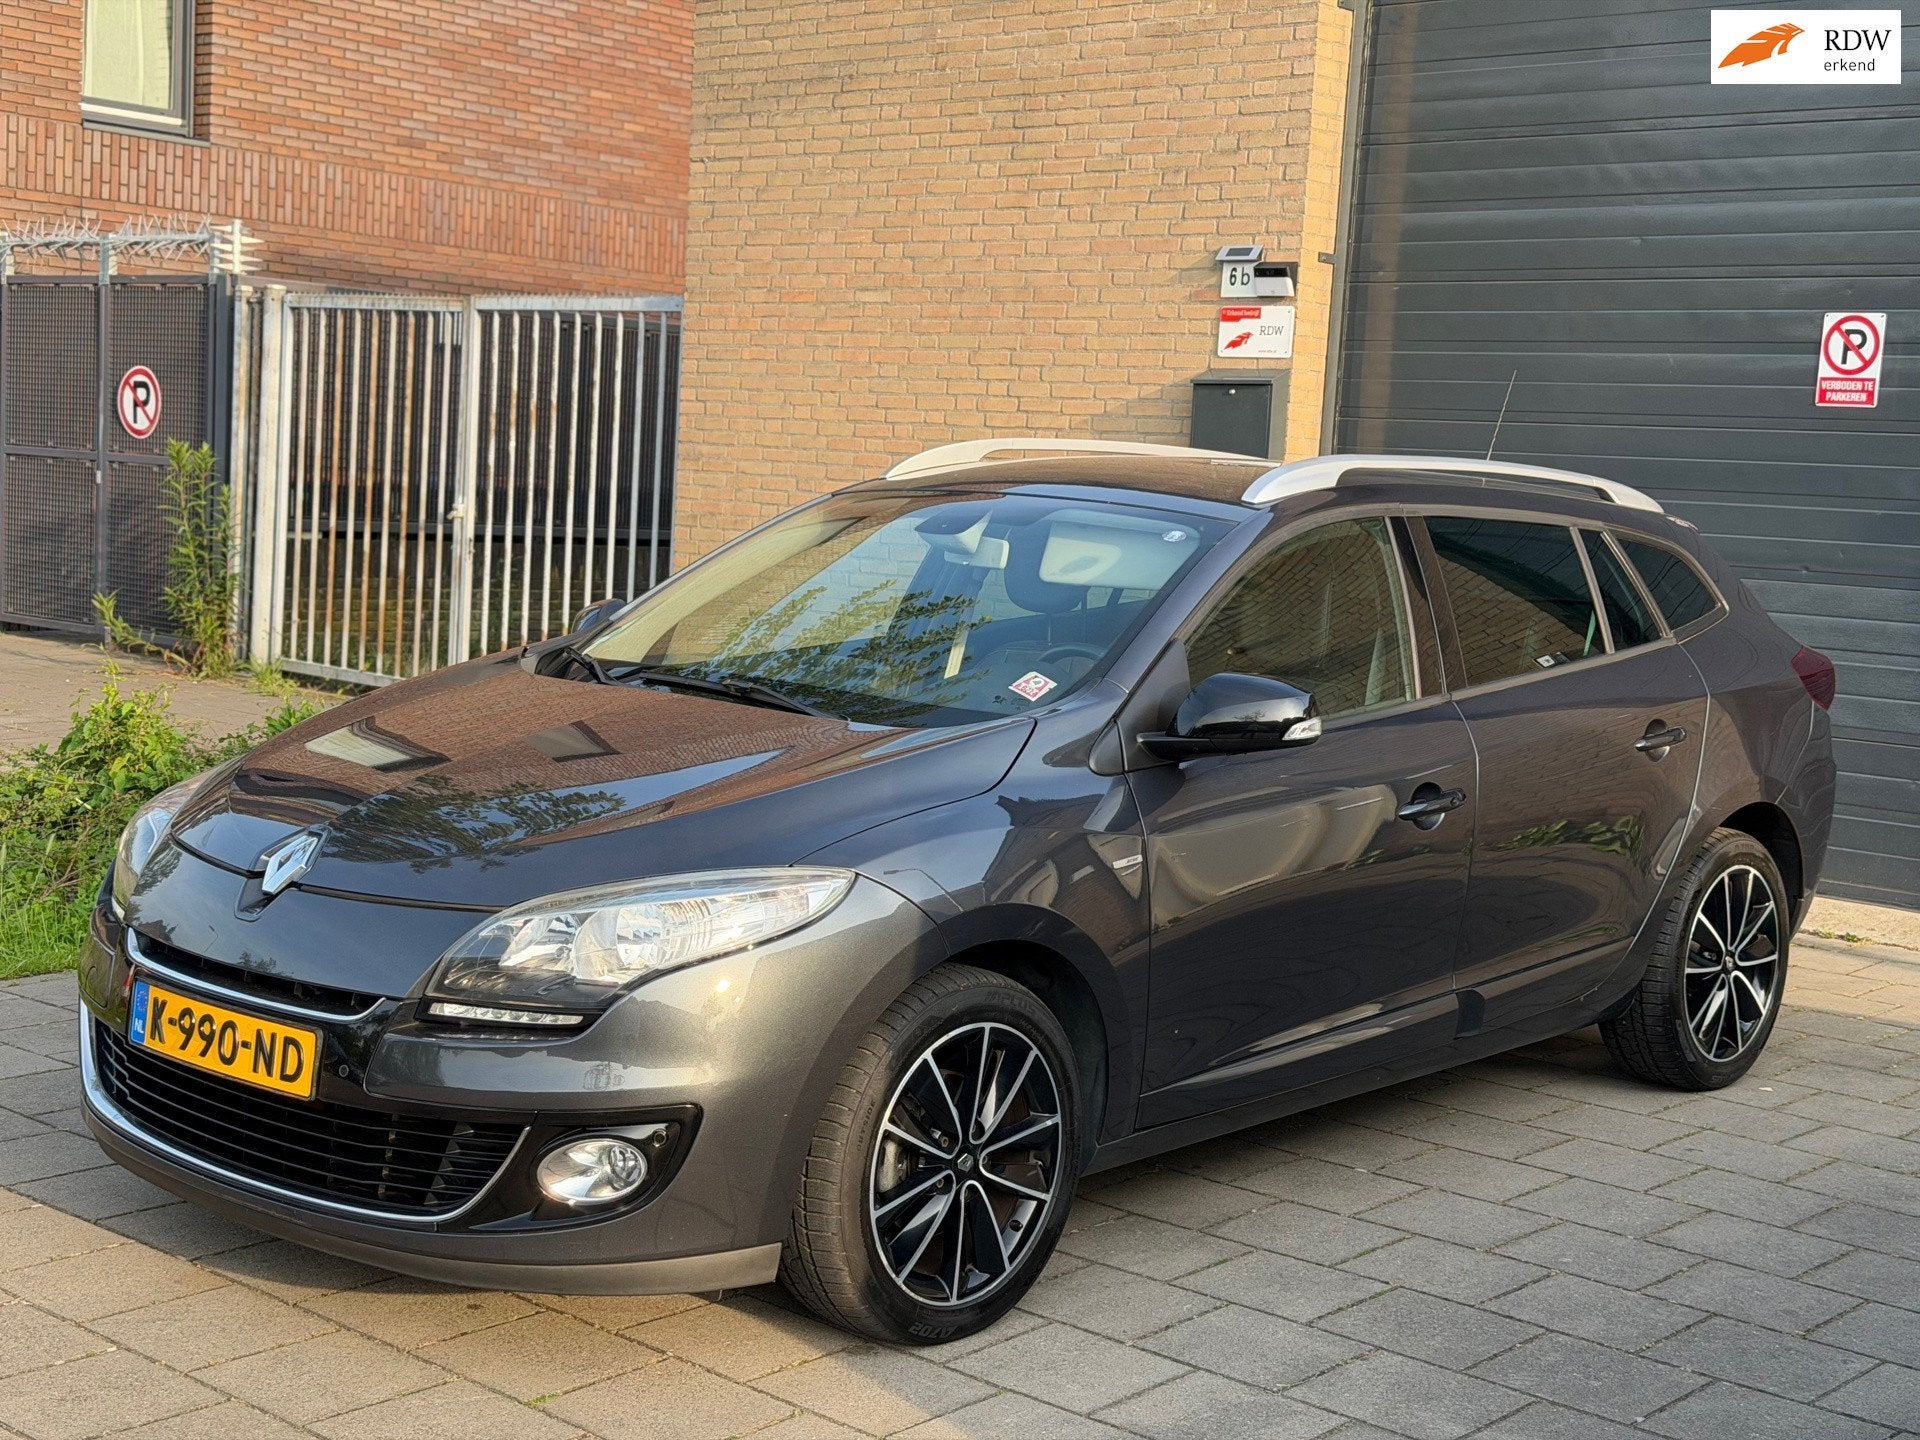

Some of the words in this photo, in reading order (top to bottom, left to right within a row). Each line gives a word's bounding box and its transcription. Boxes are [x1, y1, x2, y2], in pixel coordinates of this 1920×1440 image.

[1259, 326, 1284, 336] RDW
[1821, 380, 1863, 391] VERBODEN
[1864, 380, 1873, 390] TE
[1825, 391, 1868, 402] PARKEREN
[134, 1017, 144, 1034] NL
[150, 996, 304, 1084] K-990-ND
